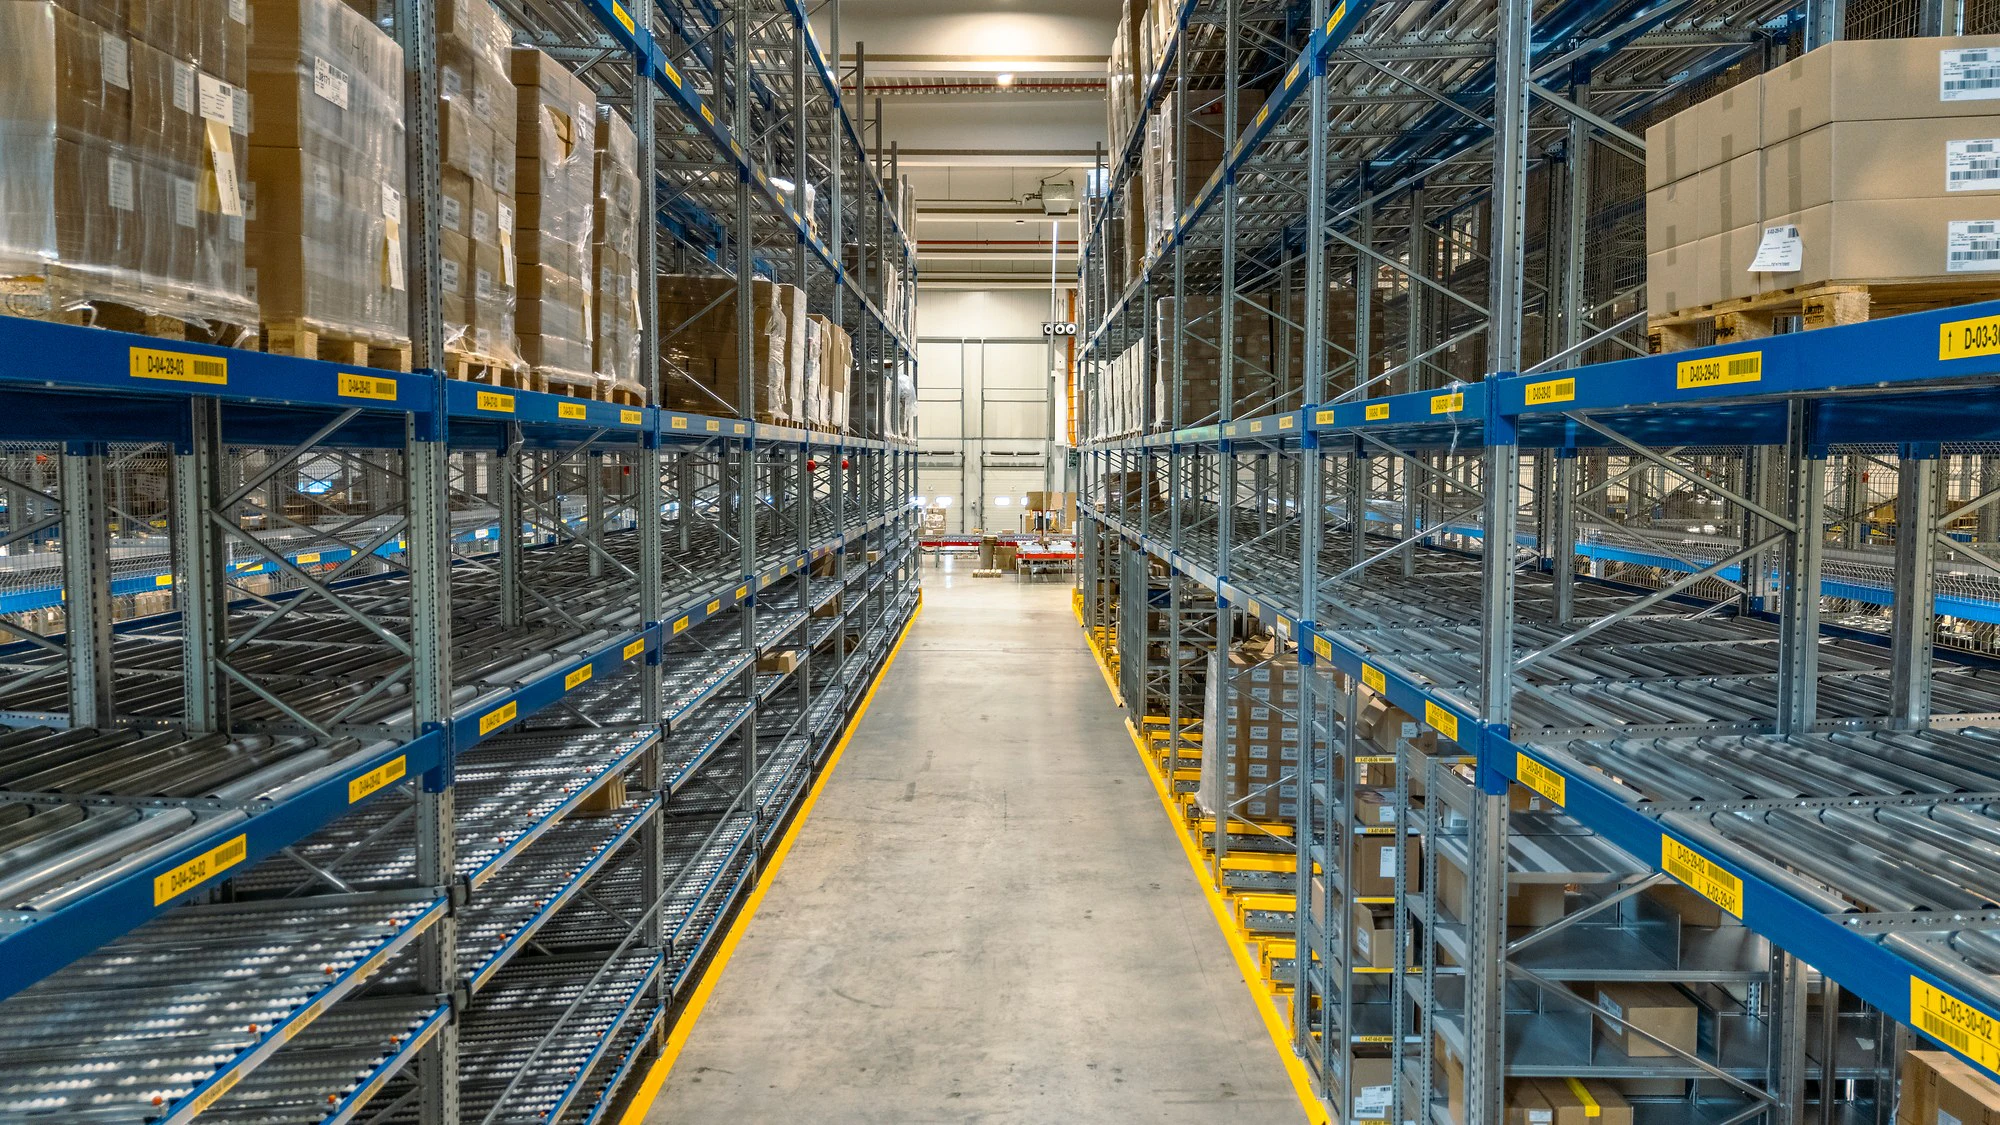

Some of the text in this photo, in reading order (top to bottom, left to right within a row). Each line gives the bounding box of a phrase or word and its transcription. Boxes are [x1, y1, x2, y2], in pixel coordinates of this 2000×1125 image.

[1964, 323, 2000, 350] D-03-3
[147, 355, 184, 376] D-04-29-03
[1689, 362, 1720, 383] D-03-29-03
[1677, 845, 1705, 875] D-03-29-02
[170, 860, 206, 893] D-04-29-02
[1706, 881, 1736, 913] X-02-29-01
[1940, 994, 1992, 1041] D-03-30-02
